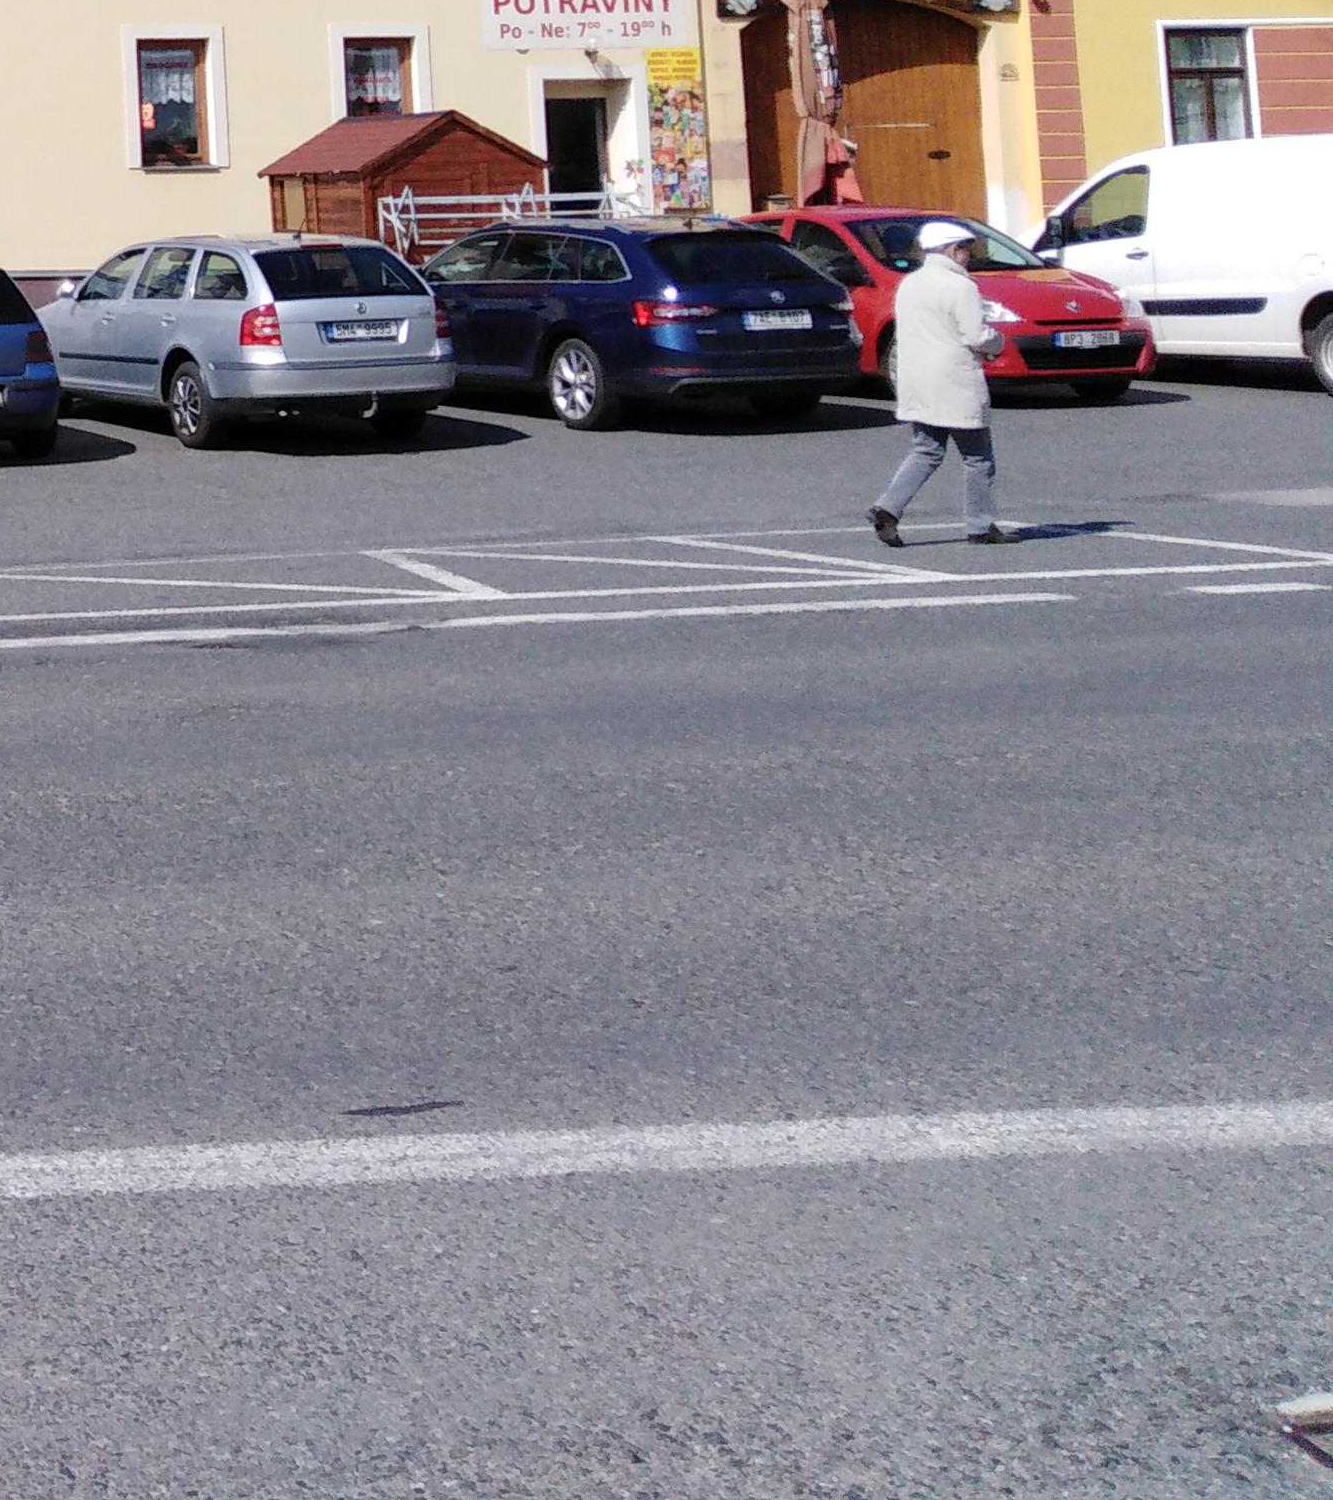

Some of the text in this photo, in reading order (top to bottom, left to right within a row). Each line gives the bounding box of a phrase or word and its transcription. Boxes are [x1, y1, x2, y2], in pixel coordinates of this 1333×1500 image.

[500, 23, 522, 39] Po
[540, 22, 571, 39] Ne:
[661, 21, 672, 37] h
